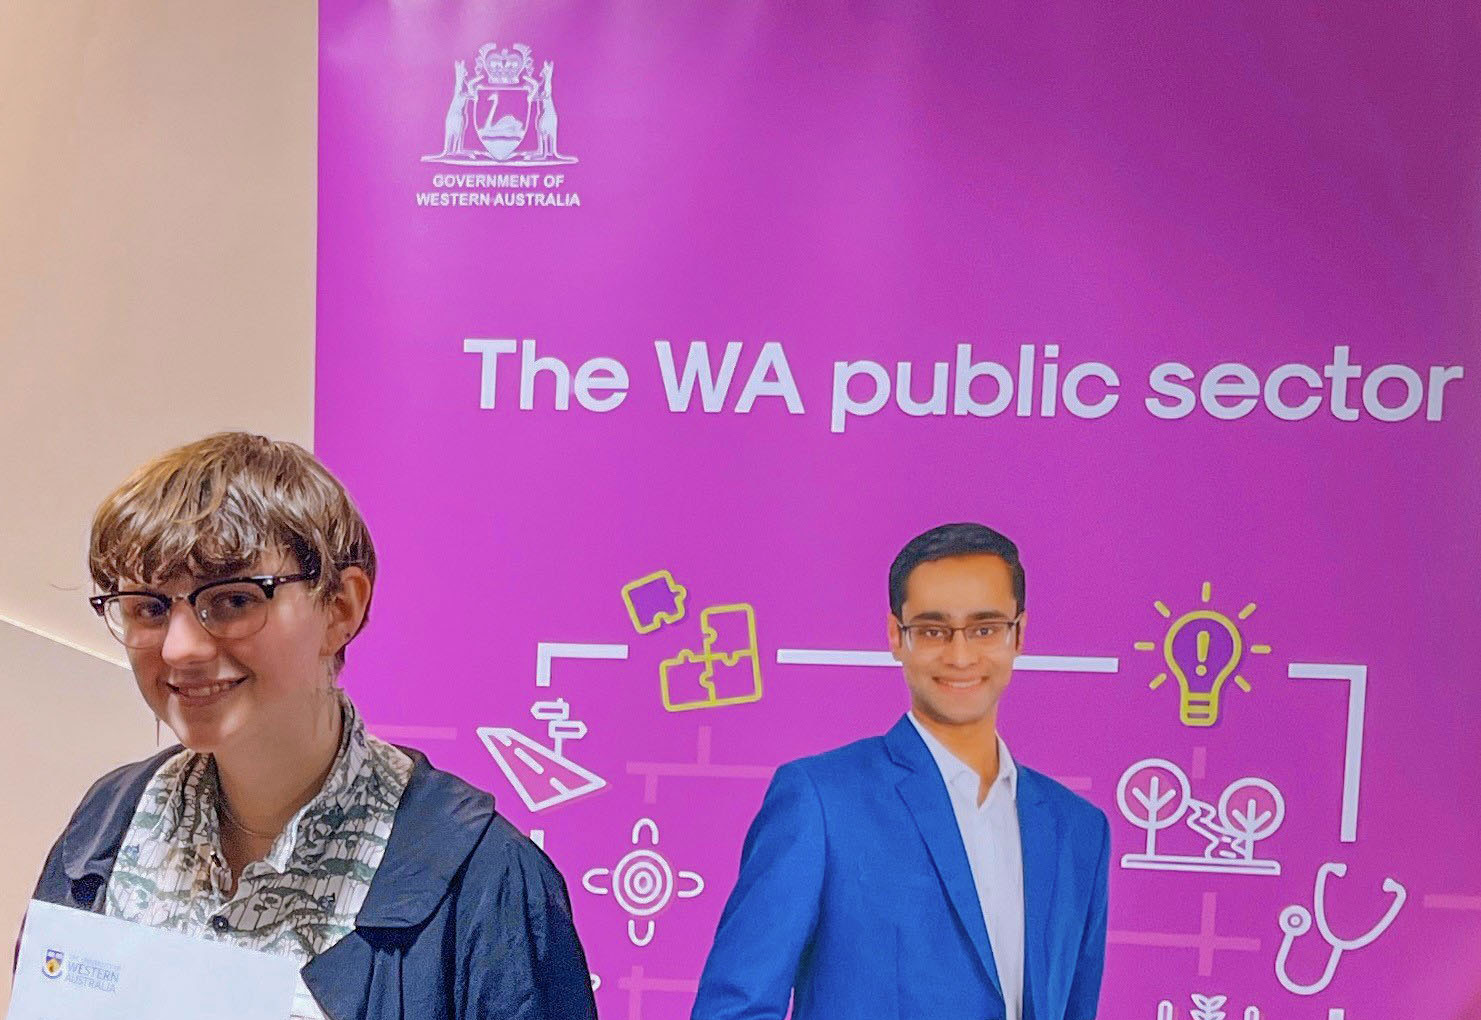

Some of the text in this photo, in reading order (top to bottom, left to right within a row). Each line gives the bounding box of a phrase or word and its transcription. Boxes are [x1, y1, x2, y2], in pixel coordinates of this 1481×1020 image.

[432, 174, 565, 188] GOVERNMENT OF
[416, 192, 581, 206] WESTERN AUSTRALIA
[463, 338, 1465, 434] The WA public sector
[66, 961, 119, 982] WESTERN
